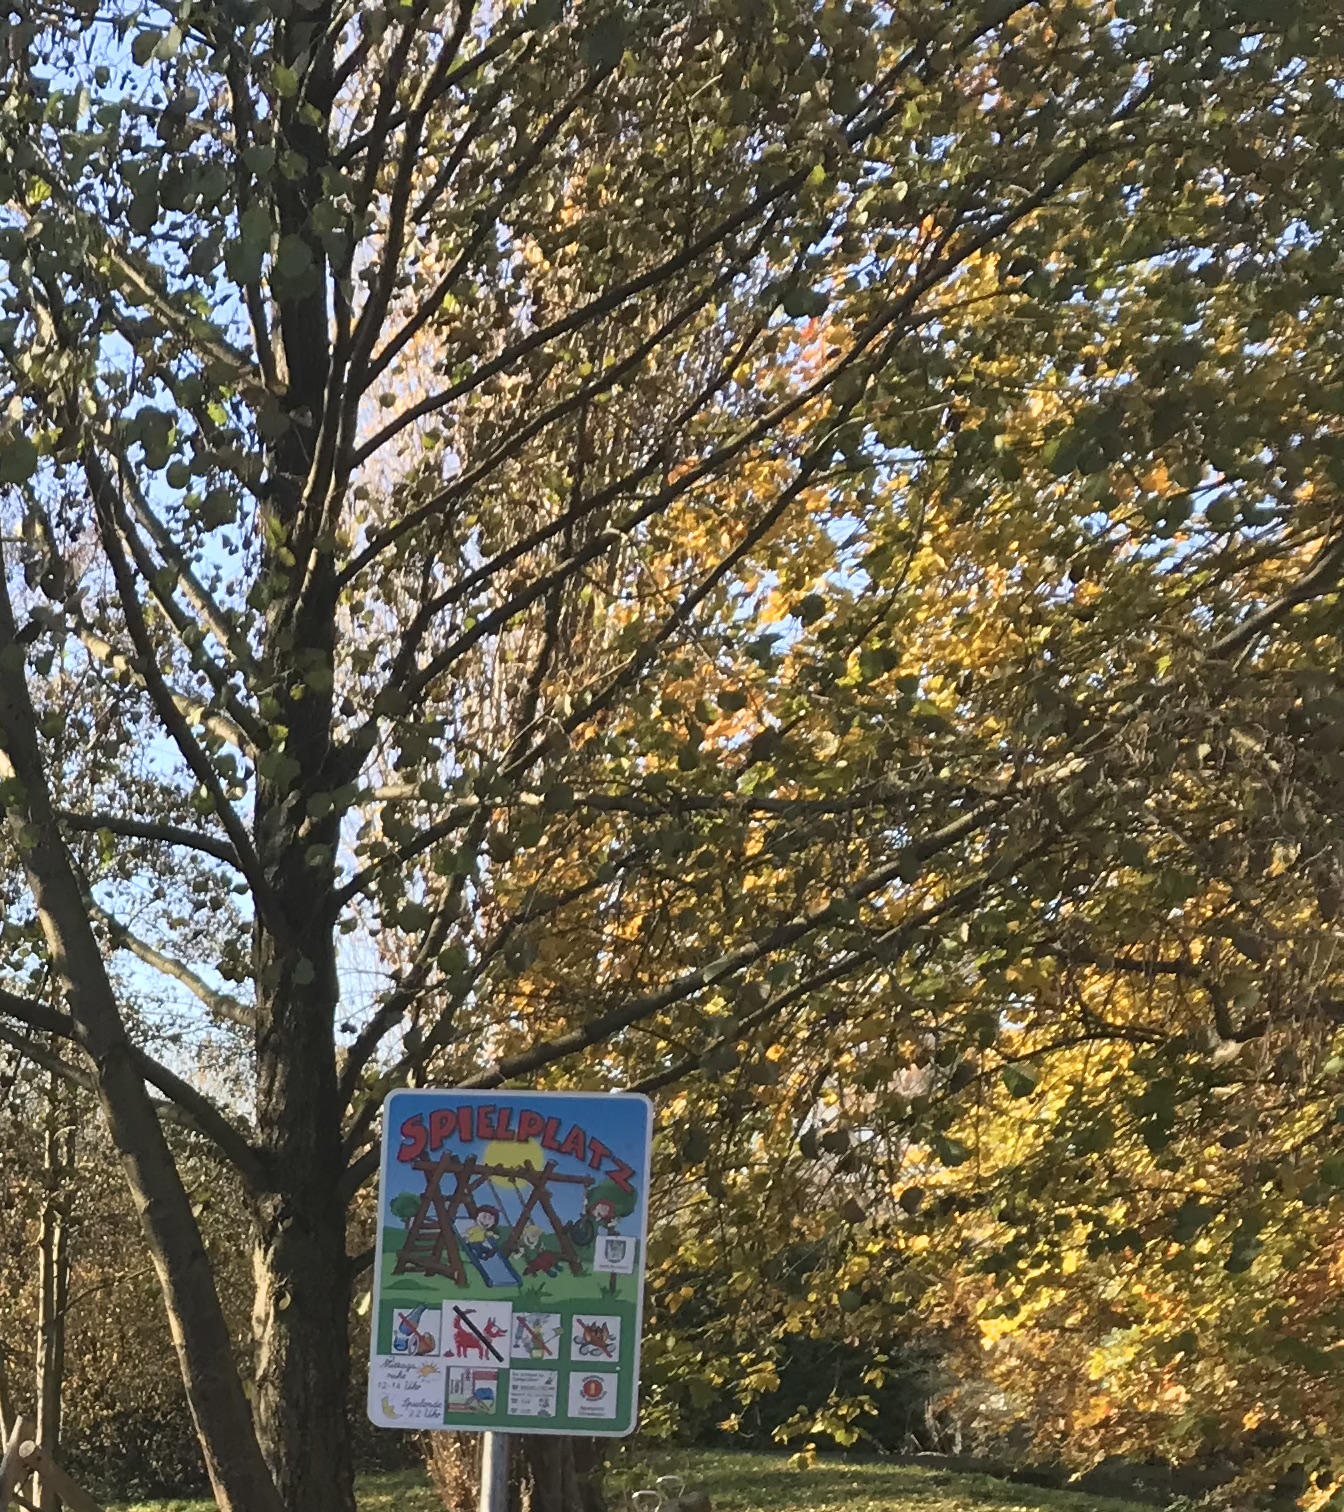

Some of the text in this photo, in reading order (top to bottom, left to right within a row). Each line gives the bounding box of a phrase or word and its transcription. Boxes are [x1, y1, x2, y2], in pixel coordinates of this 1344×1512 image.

[397, 1104, 636, 1194] SPIELPLATZ
[404, 1380, 422, 1391] Uhr
[424, 1408, 442, 1419] Uhr
